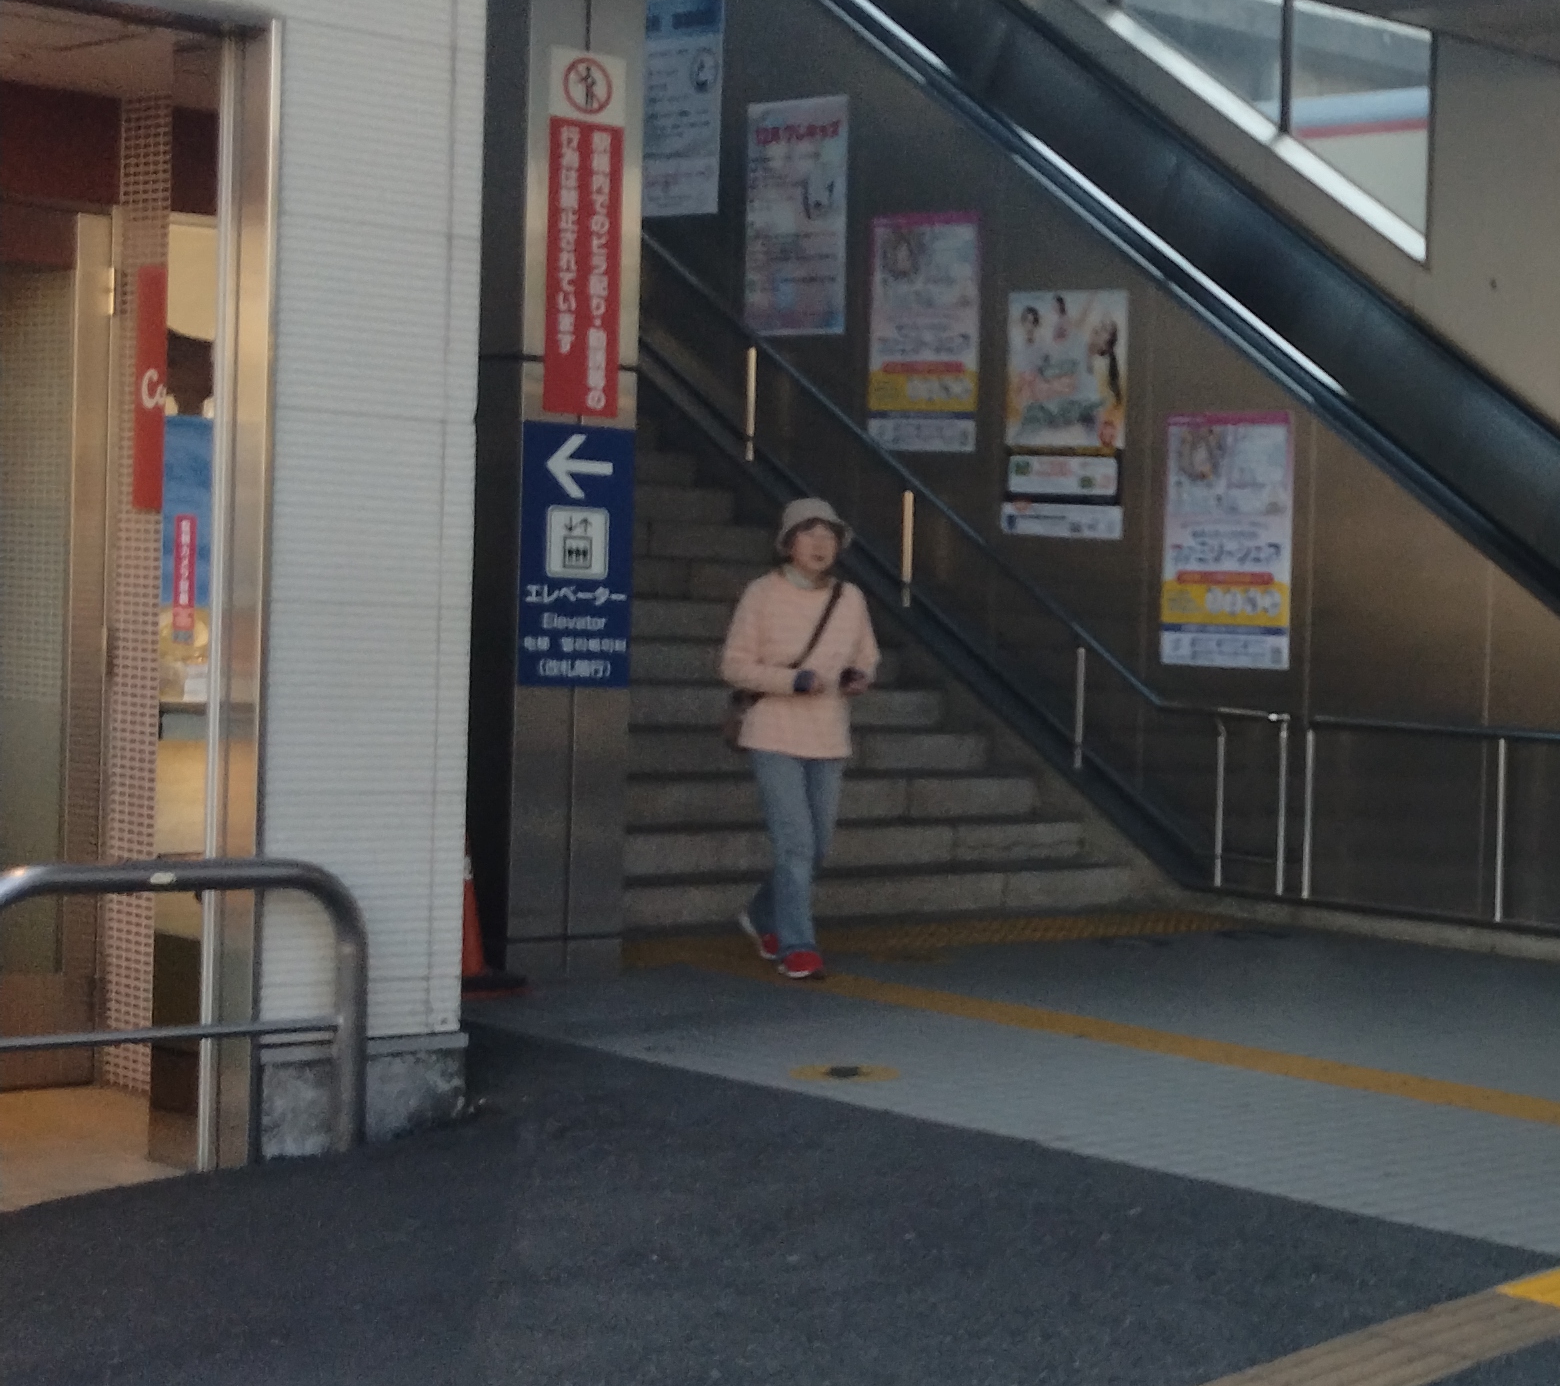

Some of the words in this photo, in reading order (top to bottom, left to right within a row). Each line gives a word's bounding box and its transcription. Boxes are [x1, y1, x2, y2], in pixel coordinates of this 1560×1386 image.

[525, 583, 627, 606] エレベーター
